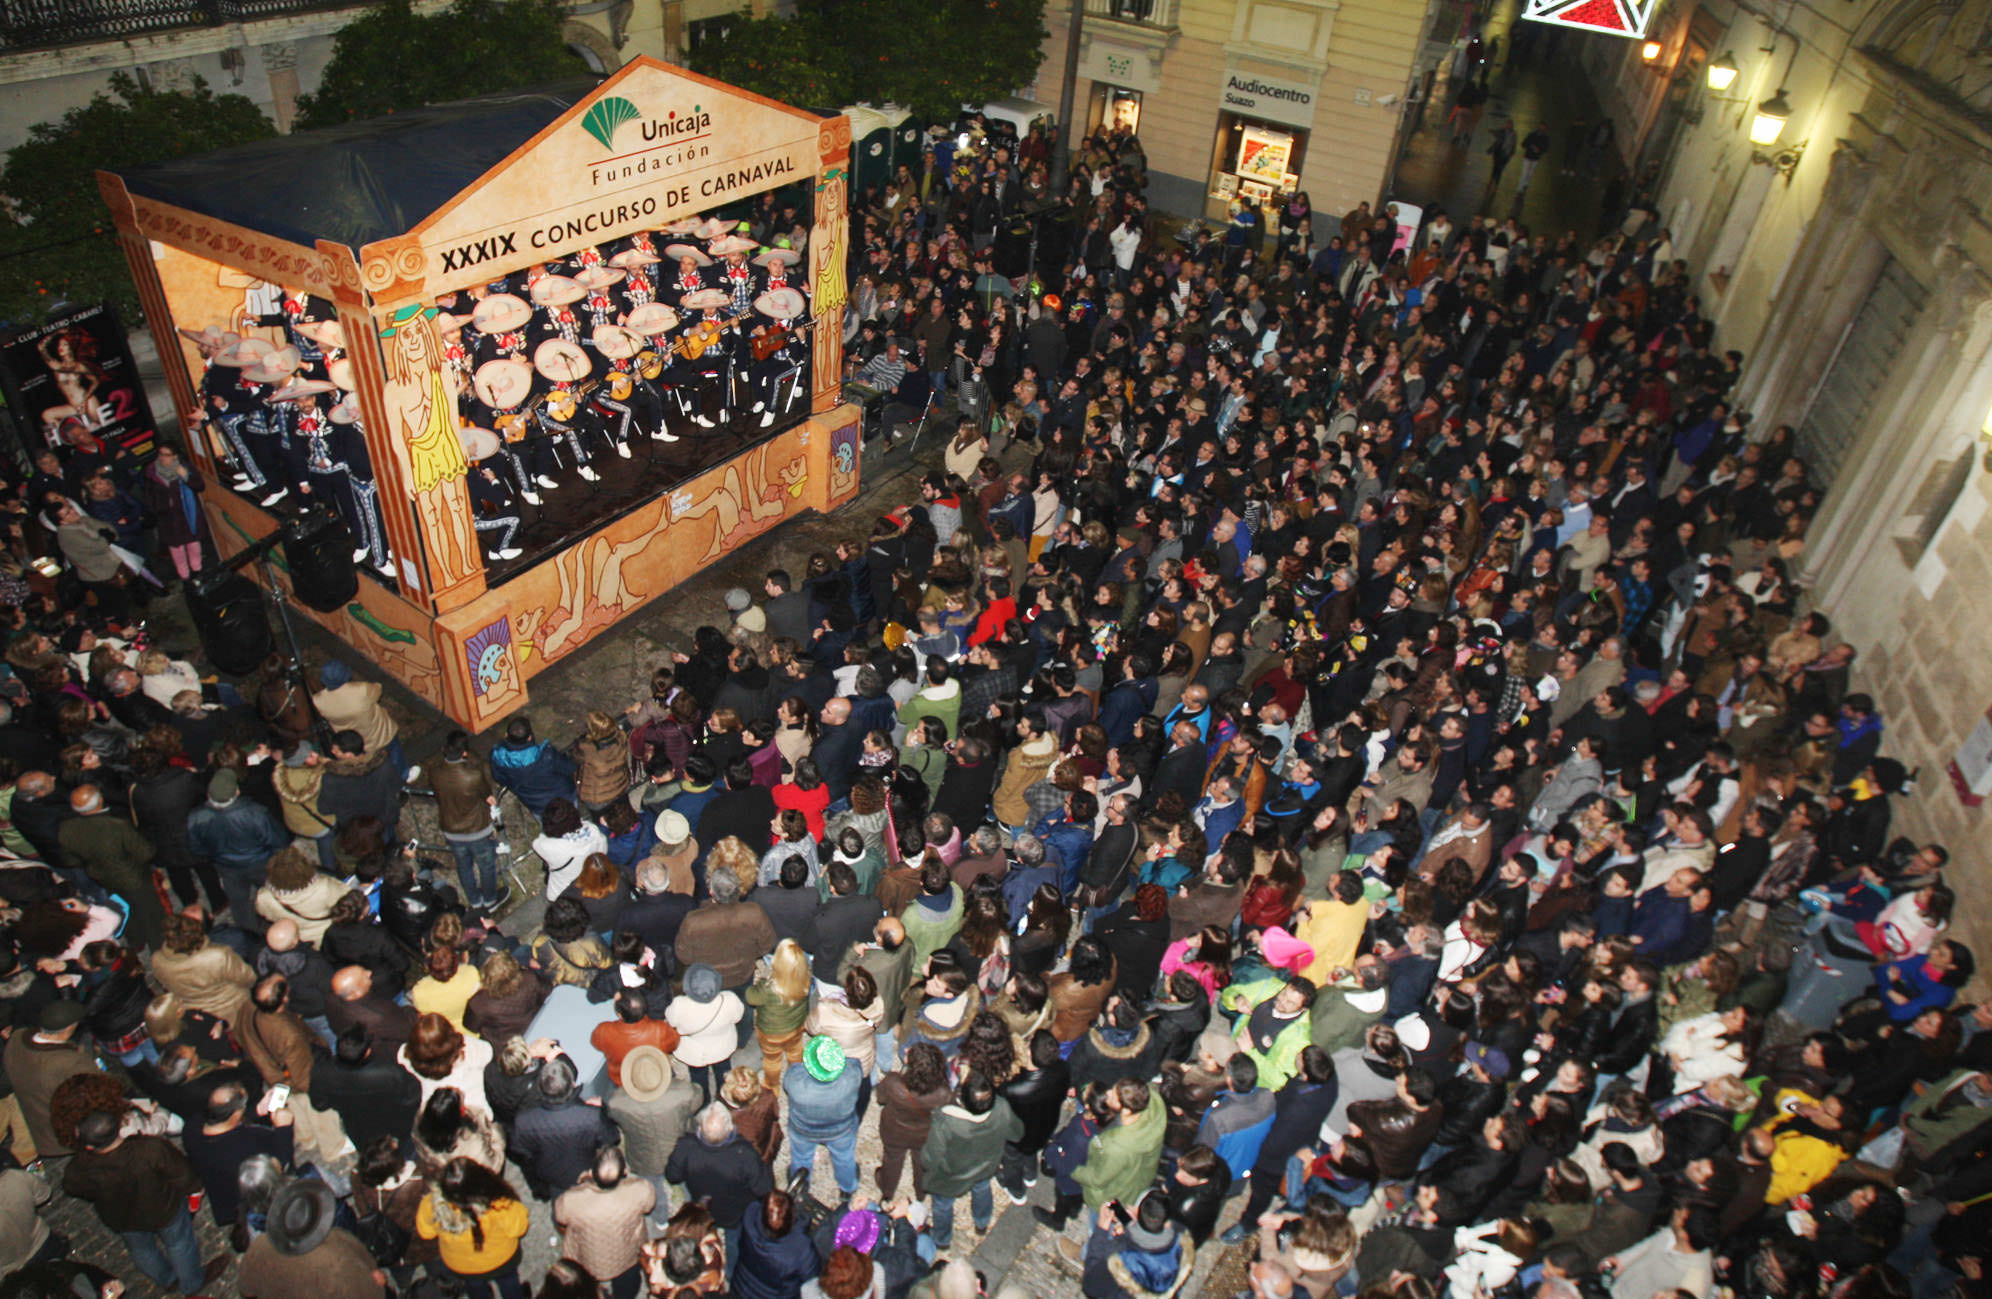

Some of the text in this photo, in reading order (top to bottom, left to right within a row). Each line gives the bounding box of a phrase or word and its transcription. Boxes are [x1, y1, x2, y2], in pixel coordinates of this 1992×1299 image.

[1228, 76, 1310, 104] Audiocentro
[642, 105, 710, 141] Unicaja
[593, 144, 710, 186] Fundación
[441, 157, 795, 273] XXXIX CONCURSO DE CARNAVAL
[18, 330, 39, 344] CLUB
